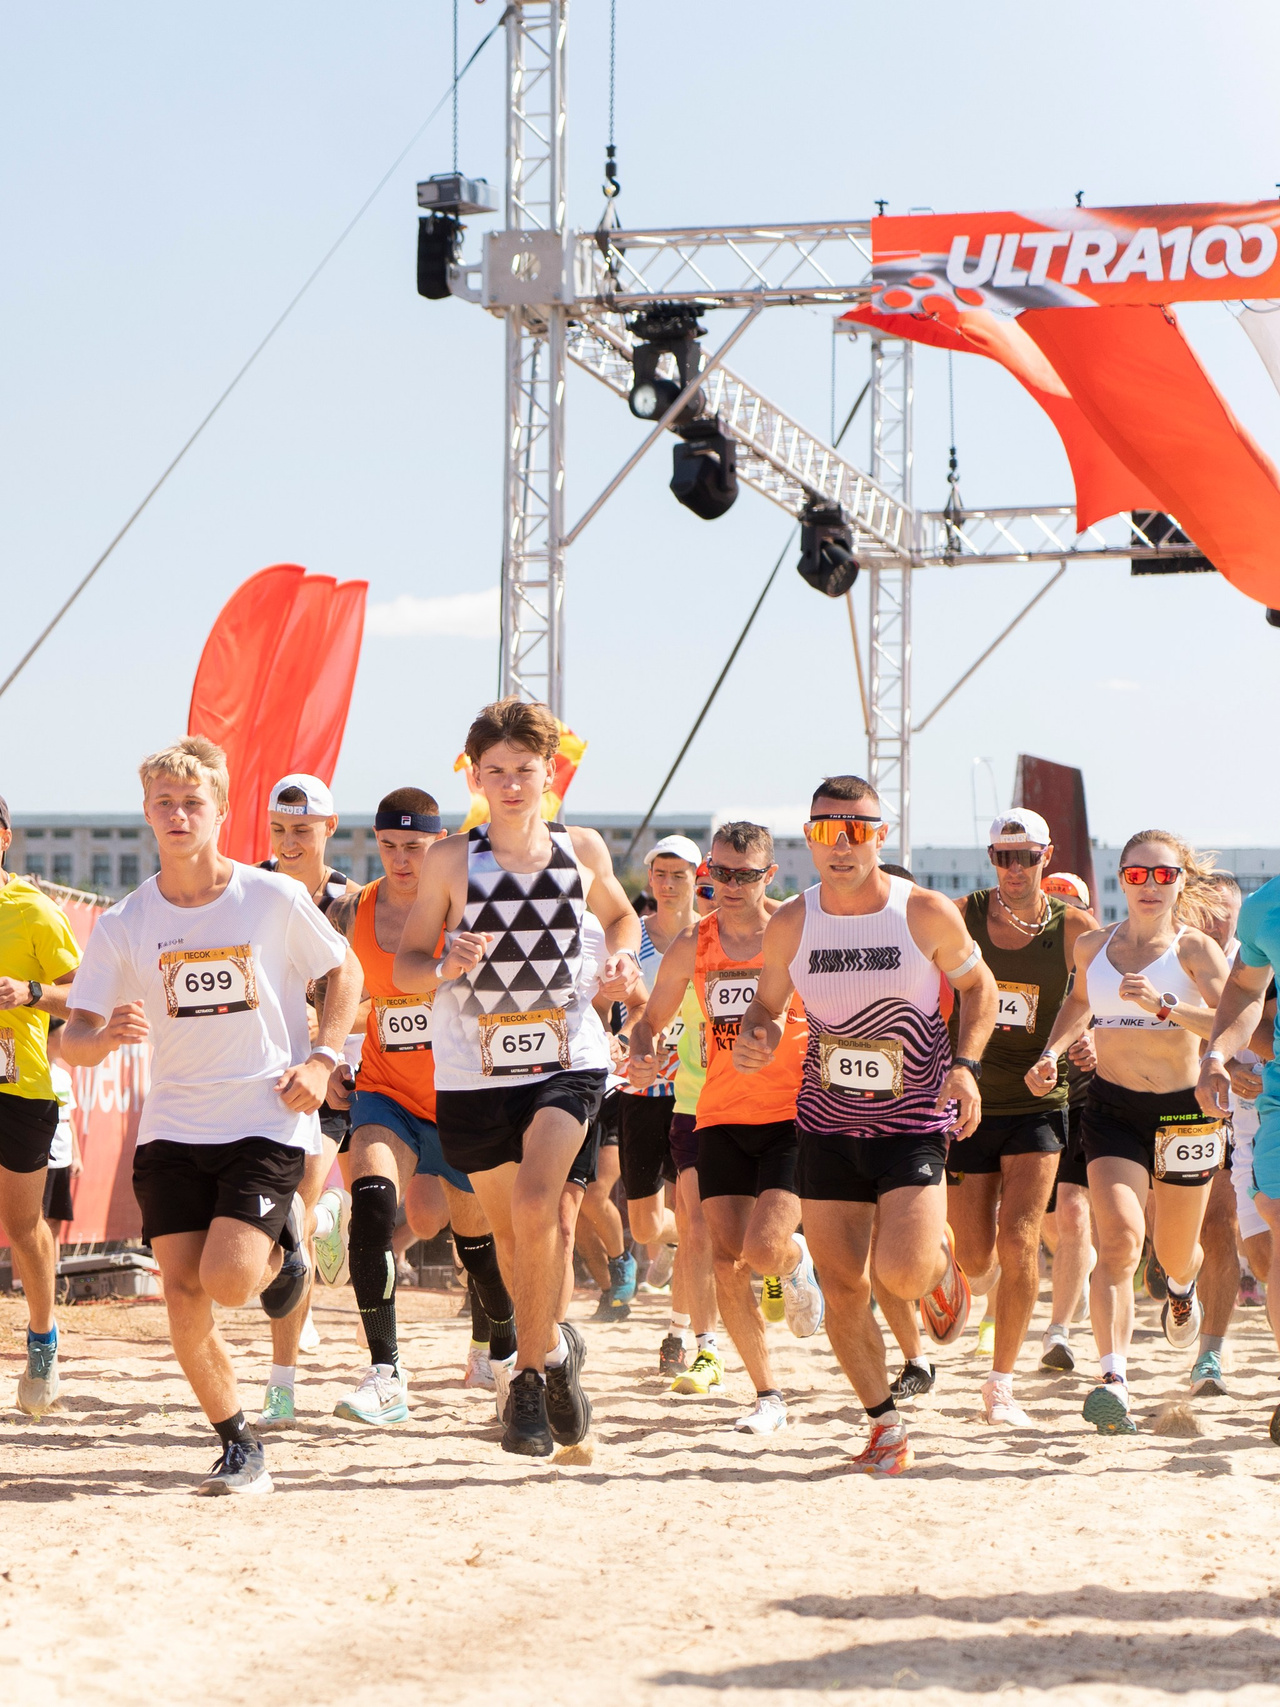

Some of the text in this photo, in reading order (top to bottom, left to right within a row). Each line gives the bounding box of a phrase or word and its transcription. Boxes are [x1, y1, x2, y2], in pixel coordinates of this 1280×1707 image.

[945, 223, 1278, 288] ULTRA100
[184, 950, 211, 960] ПЕСОК
[185, 970, 232, 993] 699
[386, 998, 408, 1006] ПЕСОК
[719, 987, 755, 1004] 870
[389, 1014, 428, 1033] 609
[500, 1014, 528, 1023] ПЕСОК
[1119, 1017, 1145, 1027] NIKE
[502, 1032, 546, 1053] 657
[838, 1039, 872, 1049] ПОЛЫНЬ
[839, 1057, 880, 1079] 816
[1176, 1142, 1215, 1161] 633
